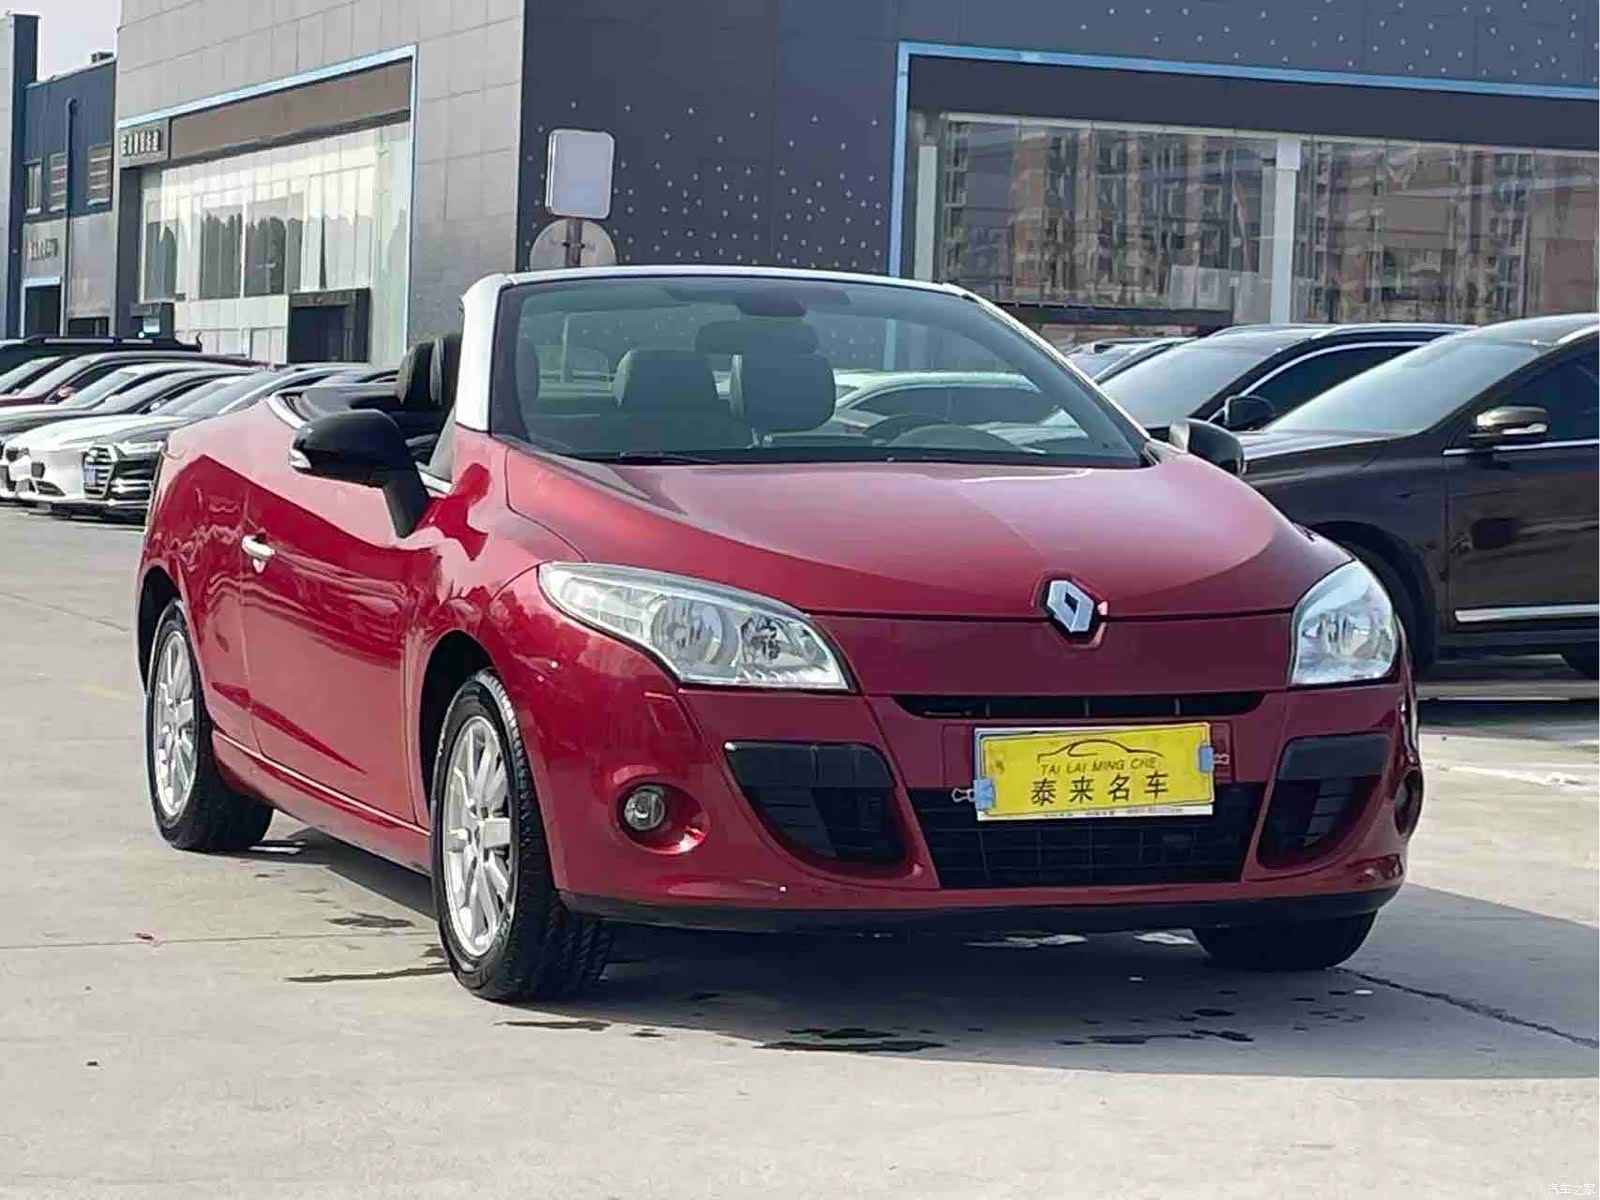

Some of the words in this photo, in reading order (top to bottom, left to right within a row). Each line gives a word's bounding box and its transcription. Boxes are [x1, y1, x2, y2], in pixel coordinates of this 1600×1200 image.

[1040, 763, 1061, 777] TAI
[1066, 762, 1088, 774] LAI
[1092, 758, 1125, 772] MING
[1130, 757, 1157, 770] CHE
[1031, 770, 1168, 806] 泰来名车
